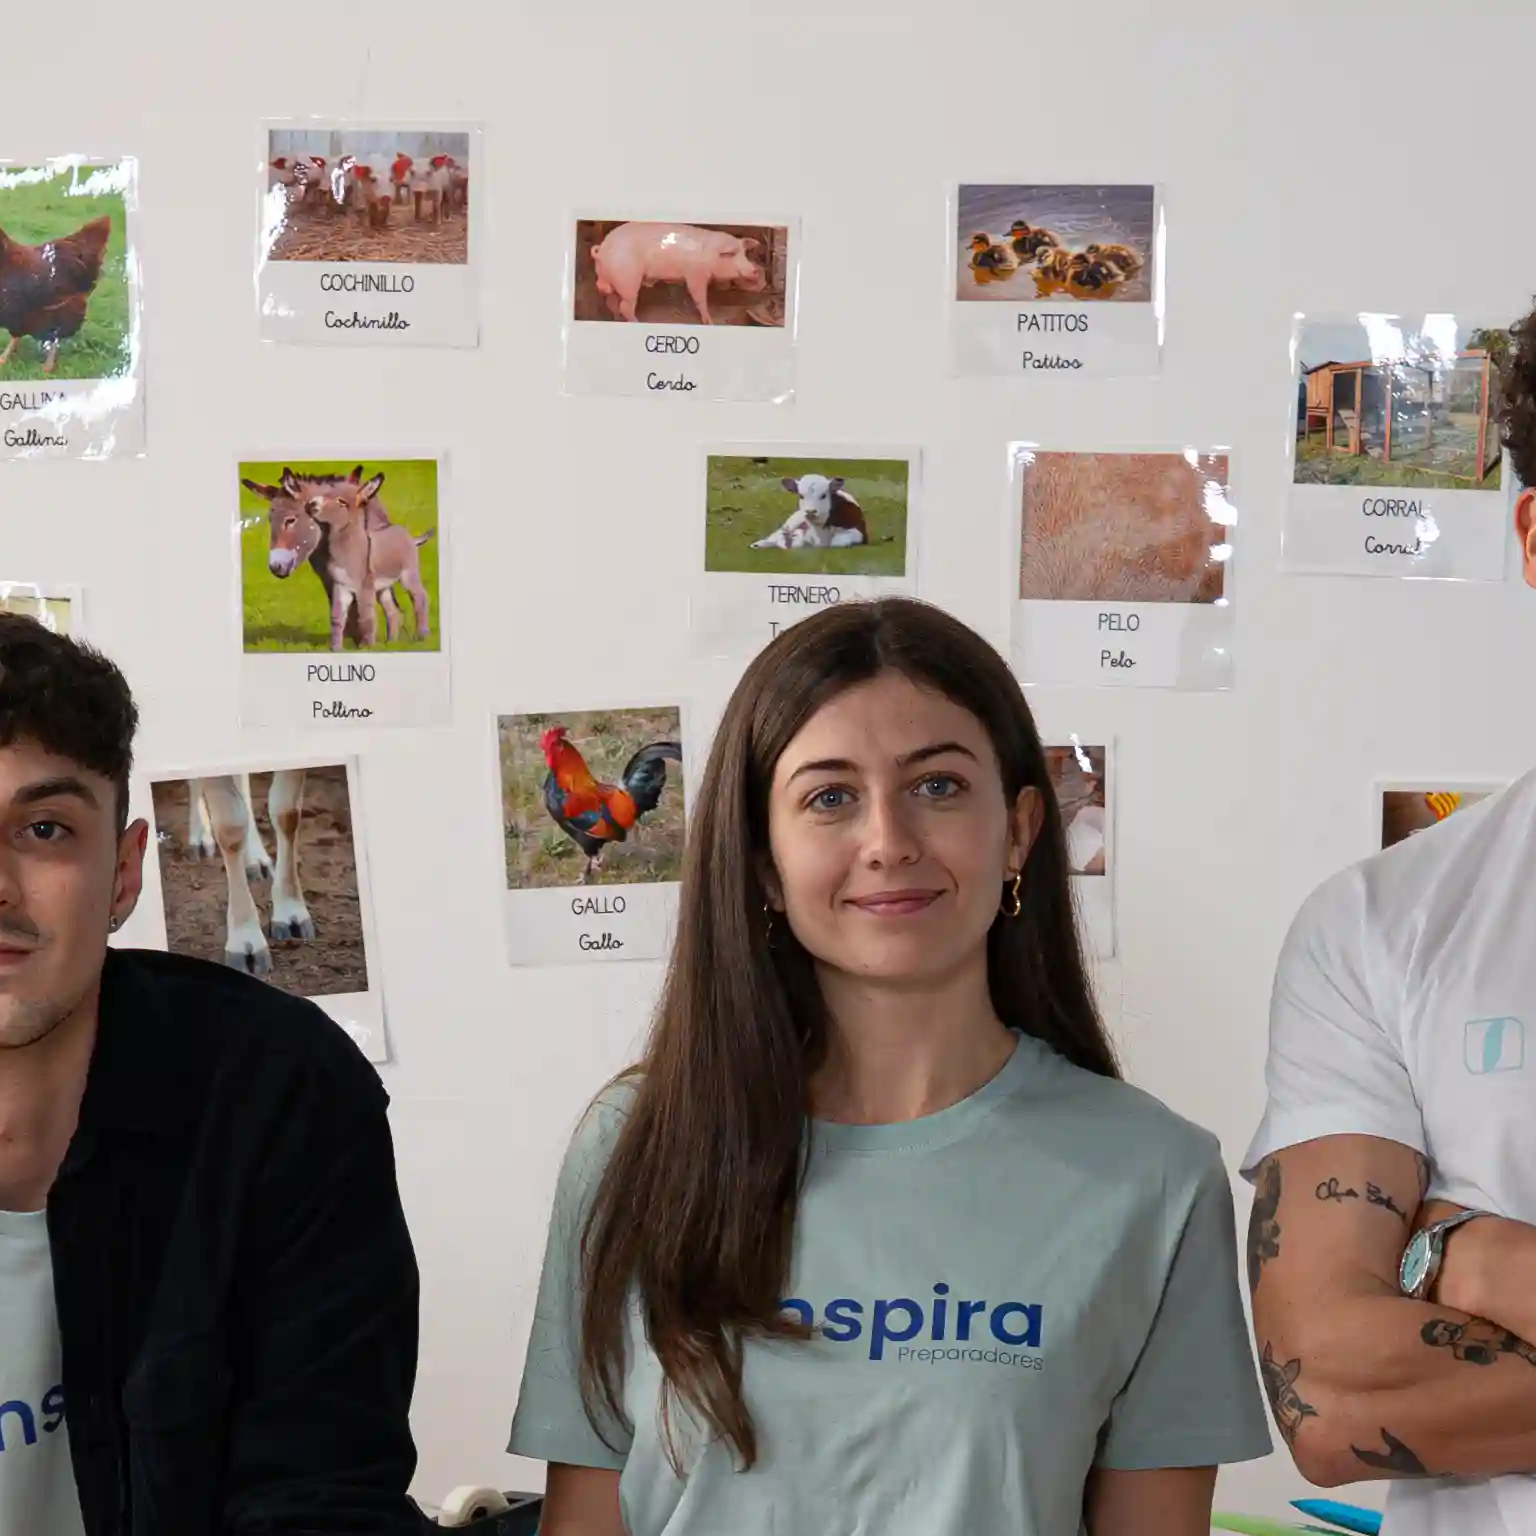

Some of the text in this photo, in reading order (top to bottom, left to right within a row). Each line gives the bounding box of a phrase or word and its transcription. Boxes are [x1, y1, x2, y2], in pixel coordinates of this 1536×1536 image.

[320, 273, 415, 293] COCHINILLO
[324, 310, 411, 330] Cochinillo
[1017, 313, 1089, 333] PATITOS
[645, 334, 700, 355] CERDO
[1022, 350, 1084, 370] Patitos
[646, 371, 698, 391] Cerdo
[4, 428, 69, 447] Gallina
[1362, 497, 1429, 519] CORRAL
[767, 584, 841, 605] TERNERO
[1097, 612, 1141, 632] PELO
[1100, 649, 1138, 669] Pelo
[306, 663, 376, 682] POLLINO
[312, 700, 374, 719] Pollino
[571, 895, 627, 916] GALLO
[578, 932, 625, 951] Gallo
[778, 1282, 1044, 1361] nspira
[897, 1346, 1044, 1371] Preparadores
